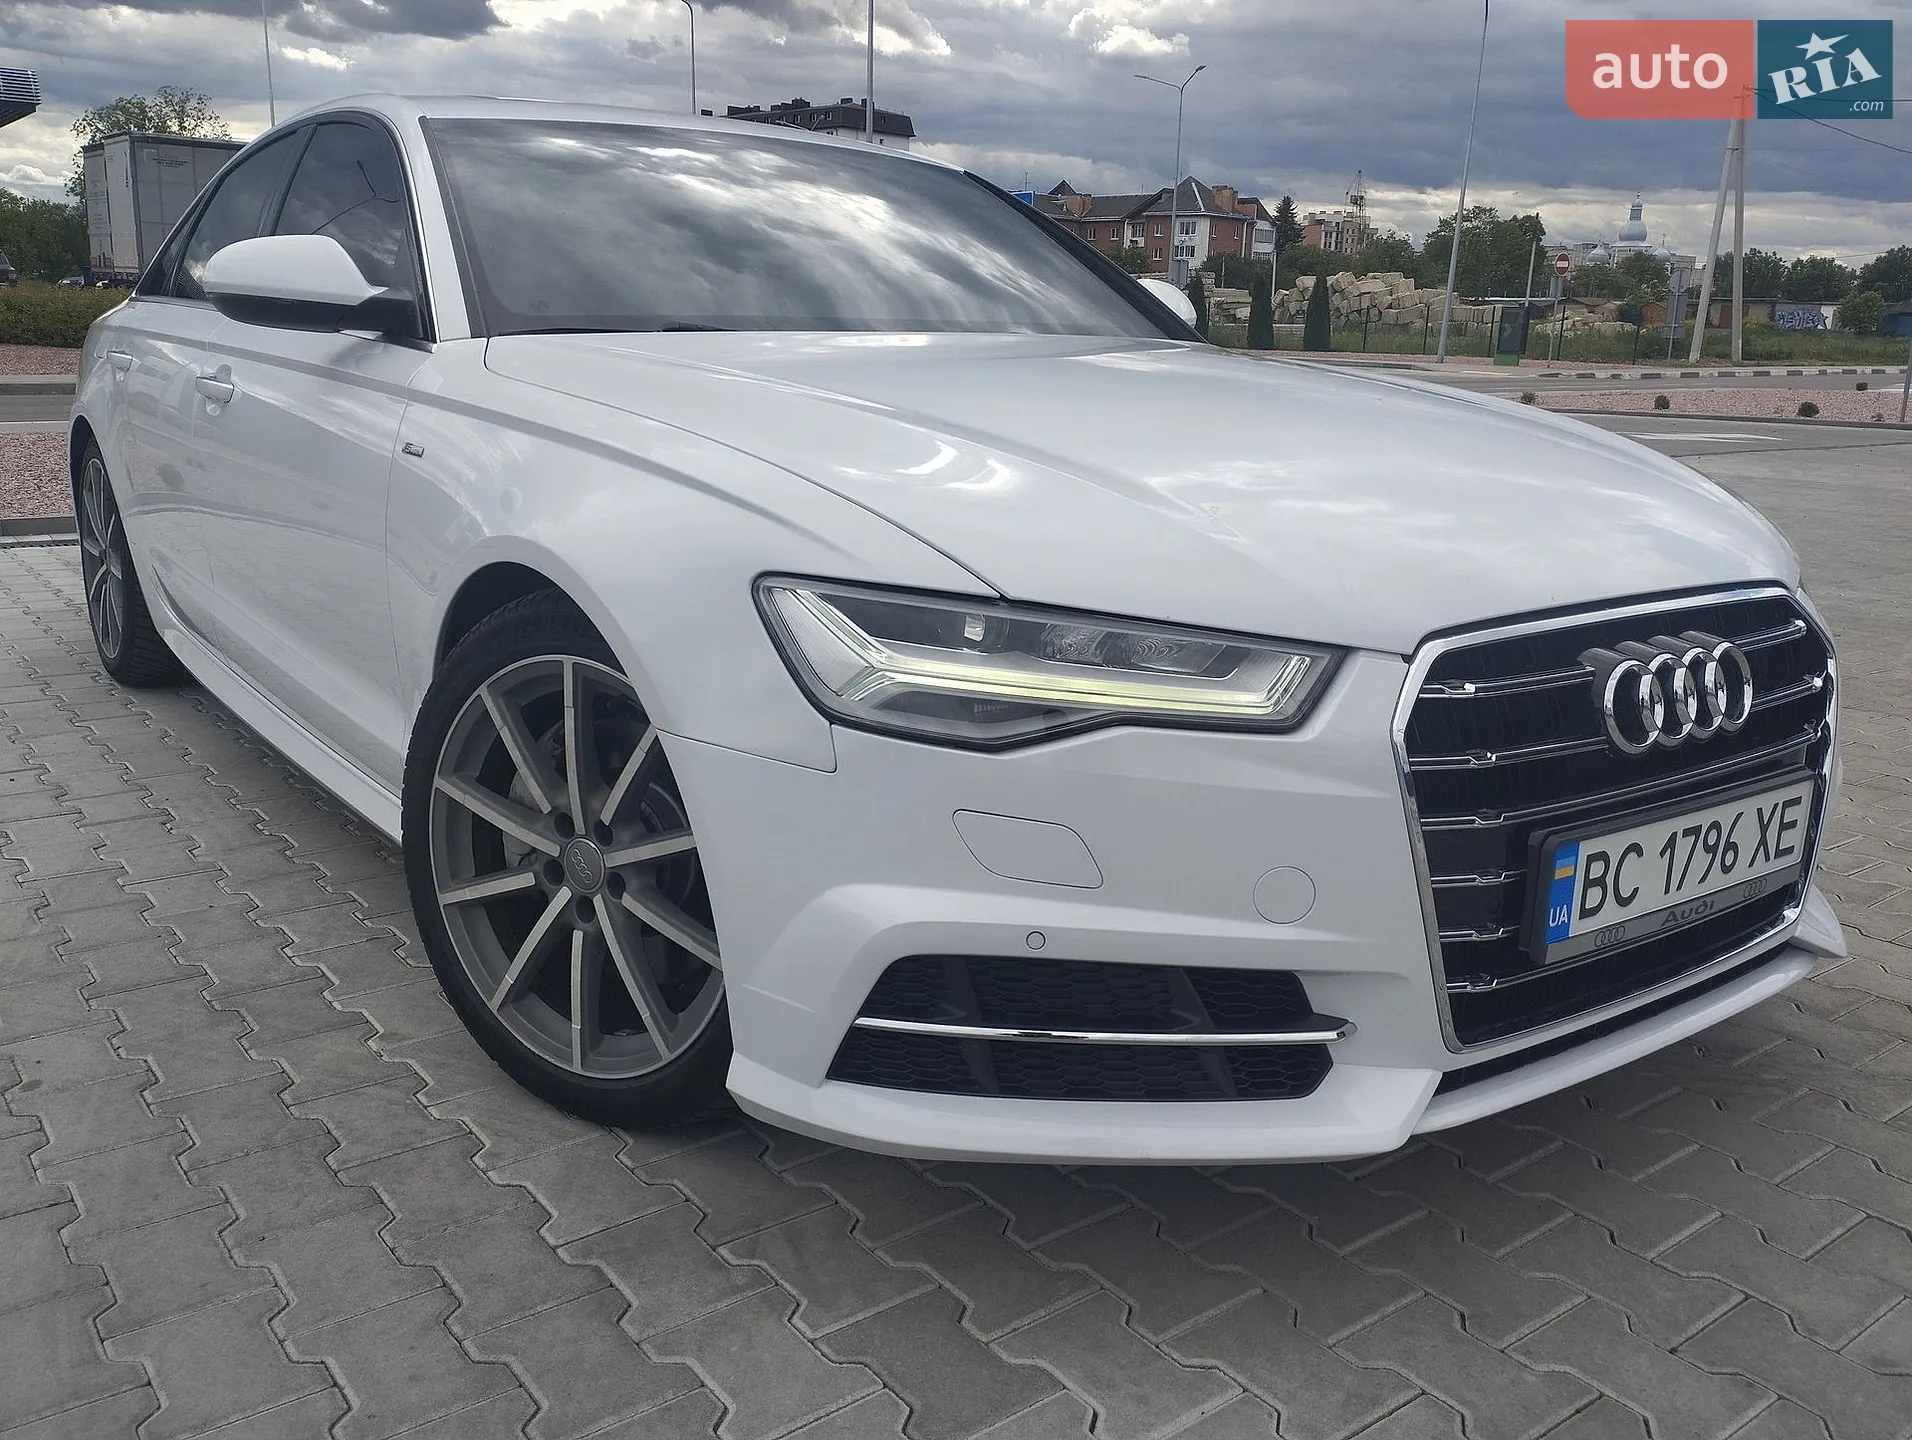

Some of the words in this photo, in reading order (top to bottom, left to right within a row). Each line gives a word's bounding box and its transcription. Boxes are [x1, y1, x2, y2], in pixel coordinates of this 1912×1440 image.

[1578, 842, 1644, 920] BC
[1659, 811, 1744, 896] 1796
[1748, 796, 1803, 868] XE
[1549, 907, 1568, 928] UA
[1661, 899, 1715, 927] Audi
